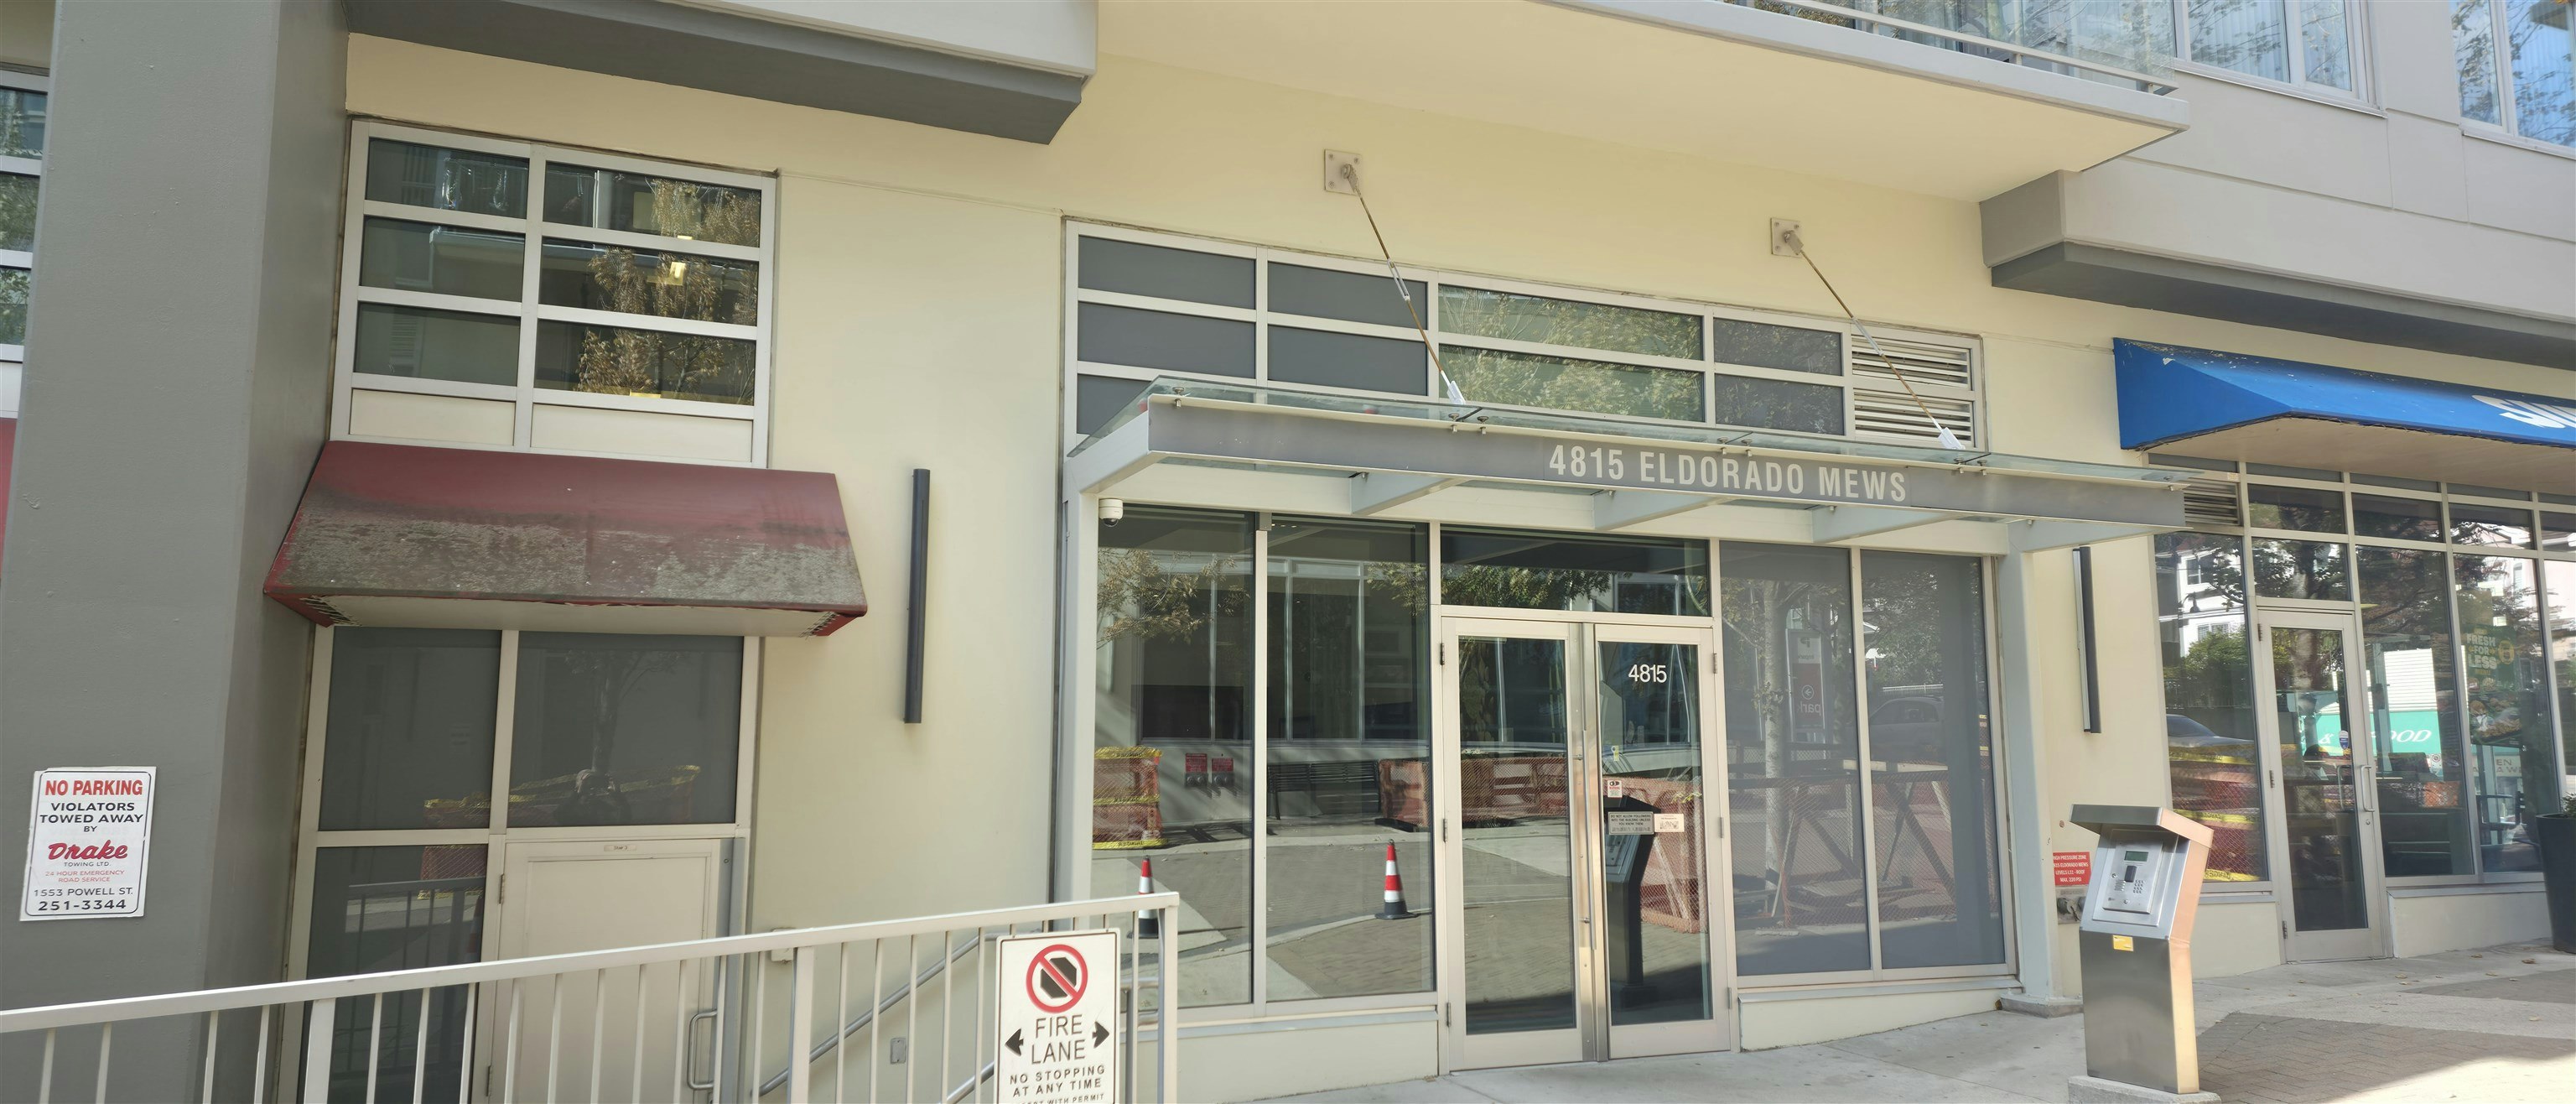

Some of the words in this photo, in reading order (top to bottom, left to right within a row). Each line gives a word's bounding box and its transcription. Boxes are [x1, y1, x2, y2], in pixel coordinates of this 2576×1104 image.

[1549, 445, 1624, 480] 4815
[1639, 450, 1805, 495] ELDORADO
[1819, 466, 1906, 503] MEWS
[2466, 633, 2496, 647] FRESH
[2474, 645, 2489, 655] FOR
[2468, 654, 2497, 669] LESS
[1628, 664, 1667, 683] 4815
[45, 780, 68, 796] NO
[72, 779, 143, 796] PARKING
[51, 802, 135, 811] VIOLATORS
[39, 814, 94, 824] TOWED
[98, 814, 144, 823] AWAY
[48, 839, 128, 860] Drake
[34, 888, 63, 897] 1553
[67, 888, 115, 896] POWELL
[118, 887, 133, 895] ST.
[38, 899, 127, 911] 251-3344
[1036, 1014, 1083, 1039] FIRE
[1031, 1039, 1086, 1065] LANE
[1010, 1074, 1028, 1085] NO
[1035, 1065, 1105, 1081] STOPPING
[1012, 1086, 1029, 1097] AT
[1036, 1082, 1063, 1095] ANY
[1069, 1078, 1101, 1091] TIME
[1073, 1093, 1104, 1103] PERMIT
